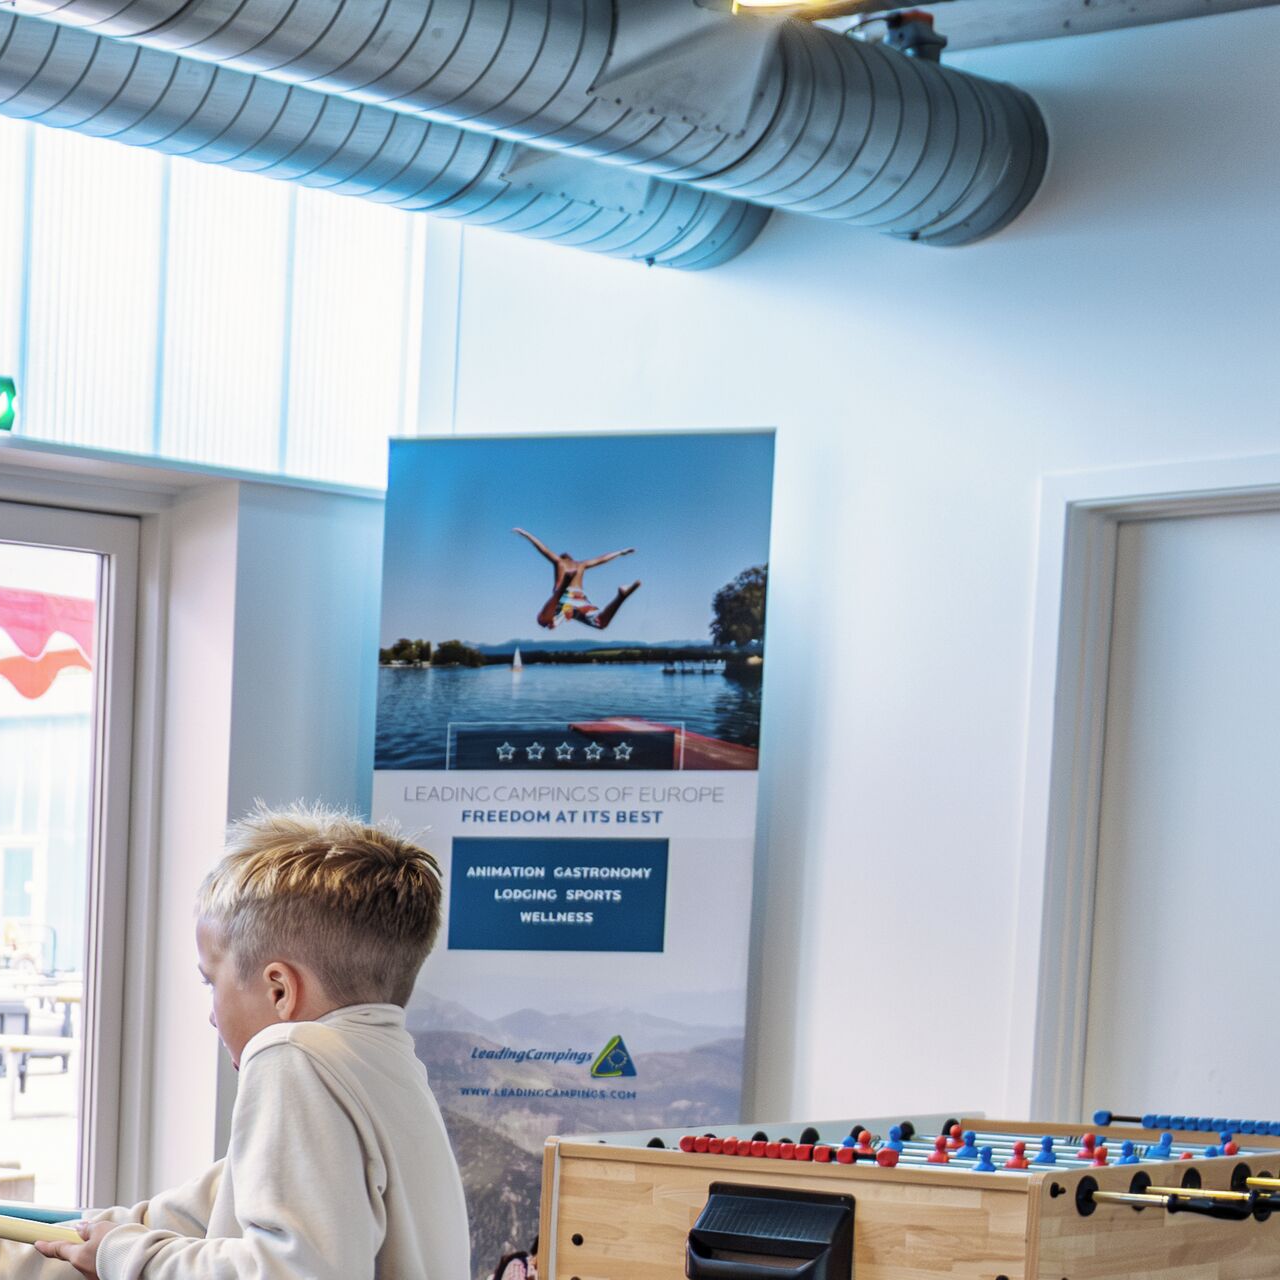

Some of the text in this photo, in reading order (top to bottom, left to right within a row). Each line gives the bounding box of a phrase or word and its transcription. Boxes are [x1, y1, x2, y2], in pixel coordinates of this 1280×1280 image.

[403, 785, 725, 803] LEADING CAMPINGS OF EUROPE
[461, 809, 664, 824] FREEDOM AT ITS BEST
[466, 866, 652, 879] ANIMATION GASTRONOMY
[494, 889, 622, 901] LODGING SPORTS
[520, 911, 594, 923] WELLNESS
[471, 1047, 593, 1064] LeadingCampings
